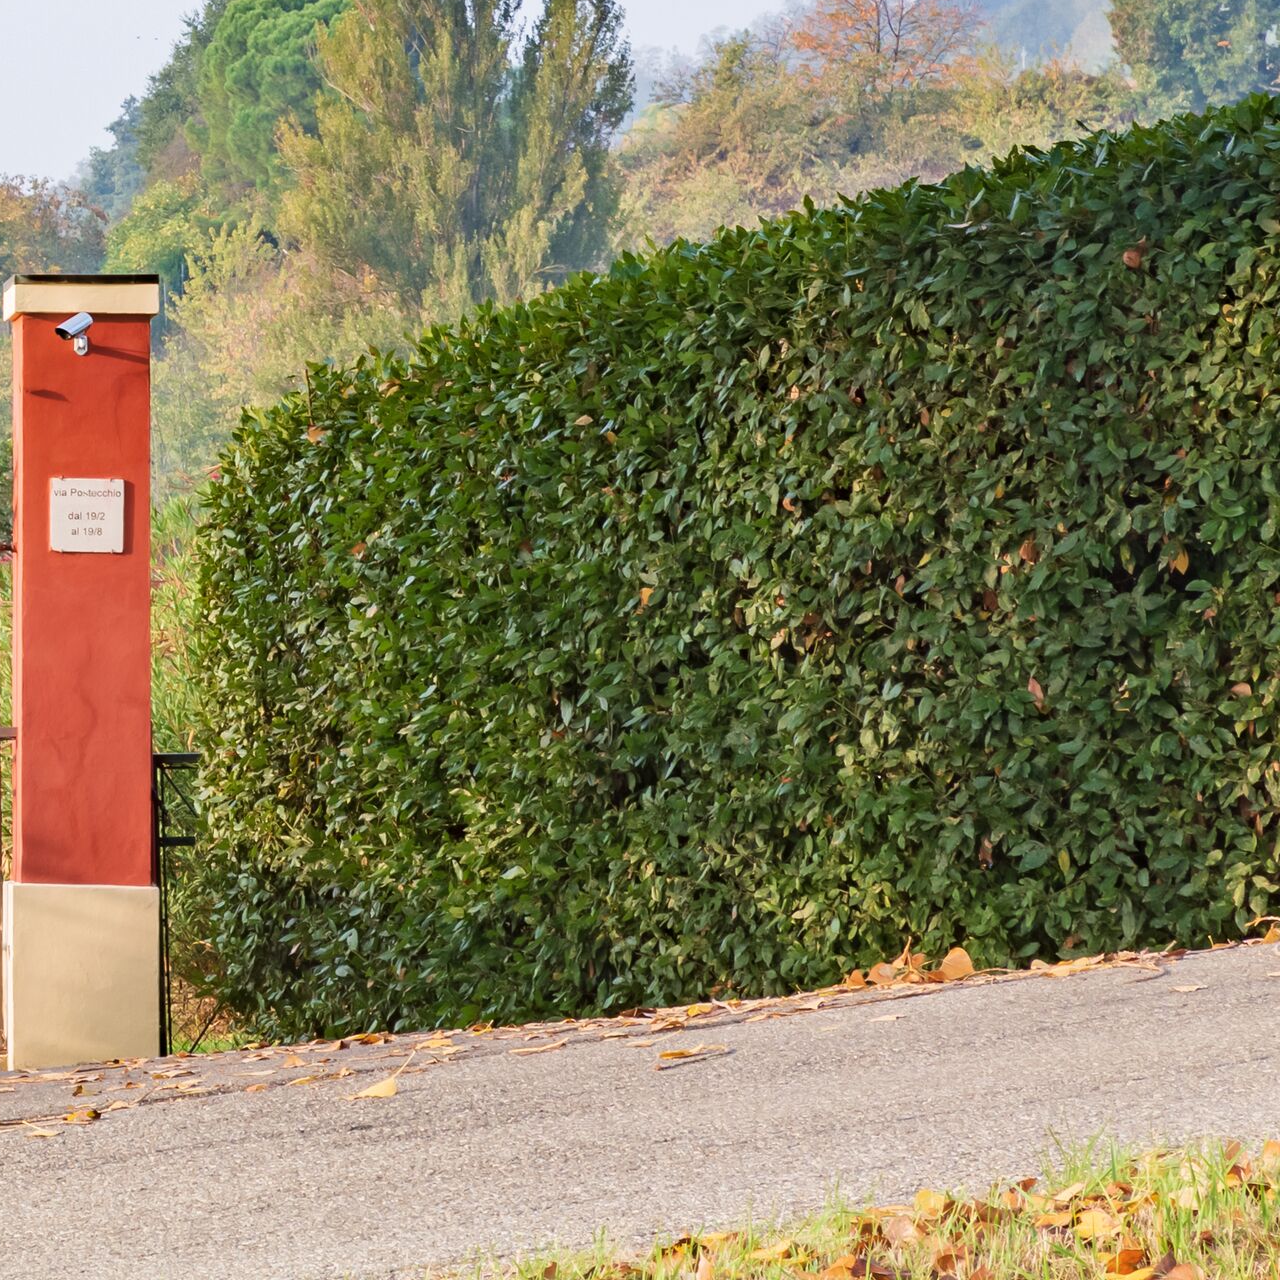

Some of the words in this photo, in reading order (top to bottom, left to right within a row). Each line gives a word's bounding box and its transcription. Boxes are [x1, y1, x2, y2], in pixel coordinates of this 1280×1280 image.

[54, 489, 67, 497] via
[68, 512, 82, 520] dal
[86, 512, 106, 521] 19/2
[71, 528, 80, 536] al
[83, 528, 103, 536] 19/8
